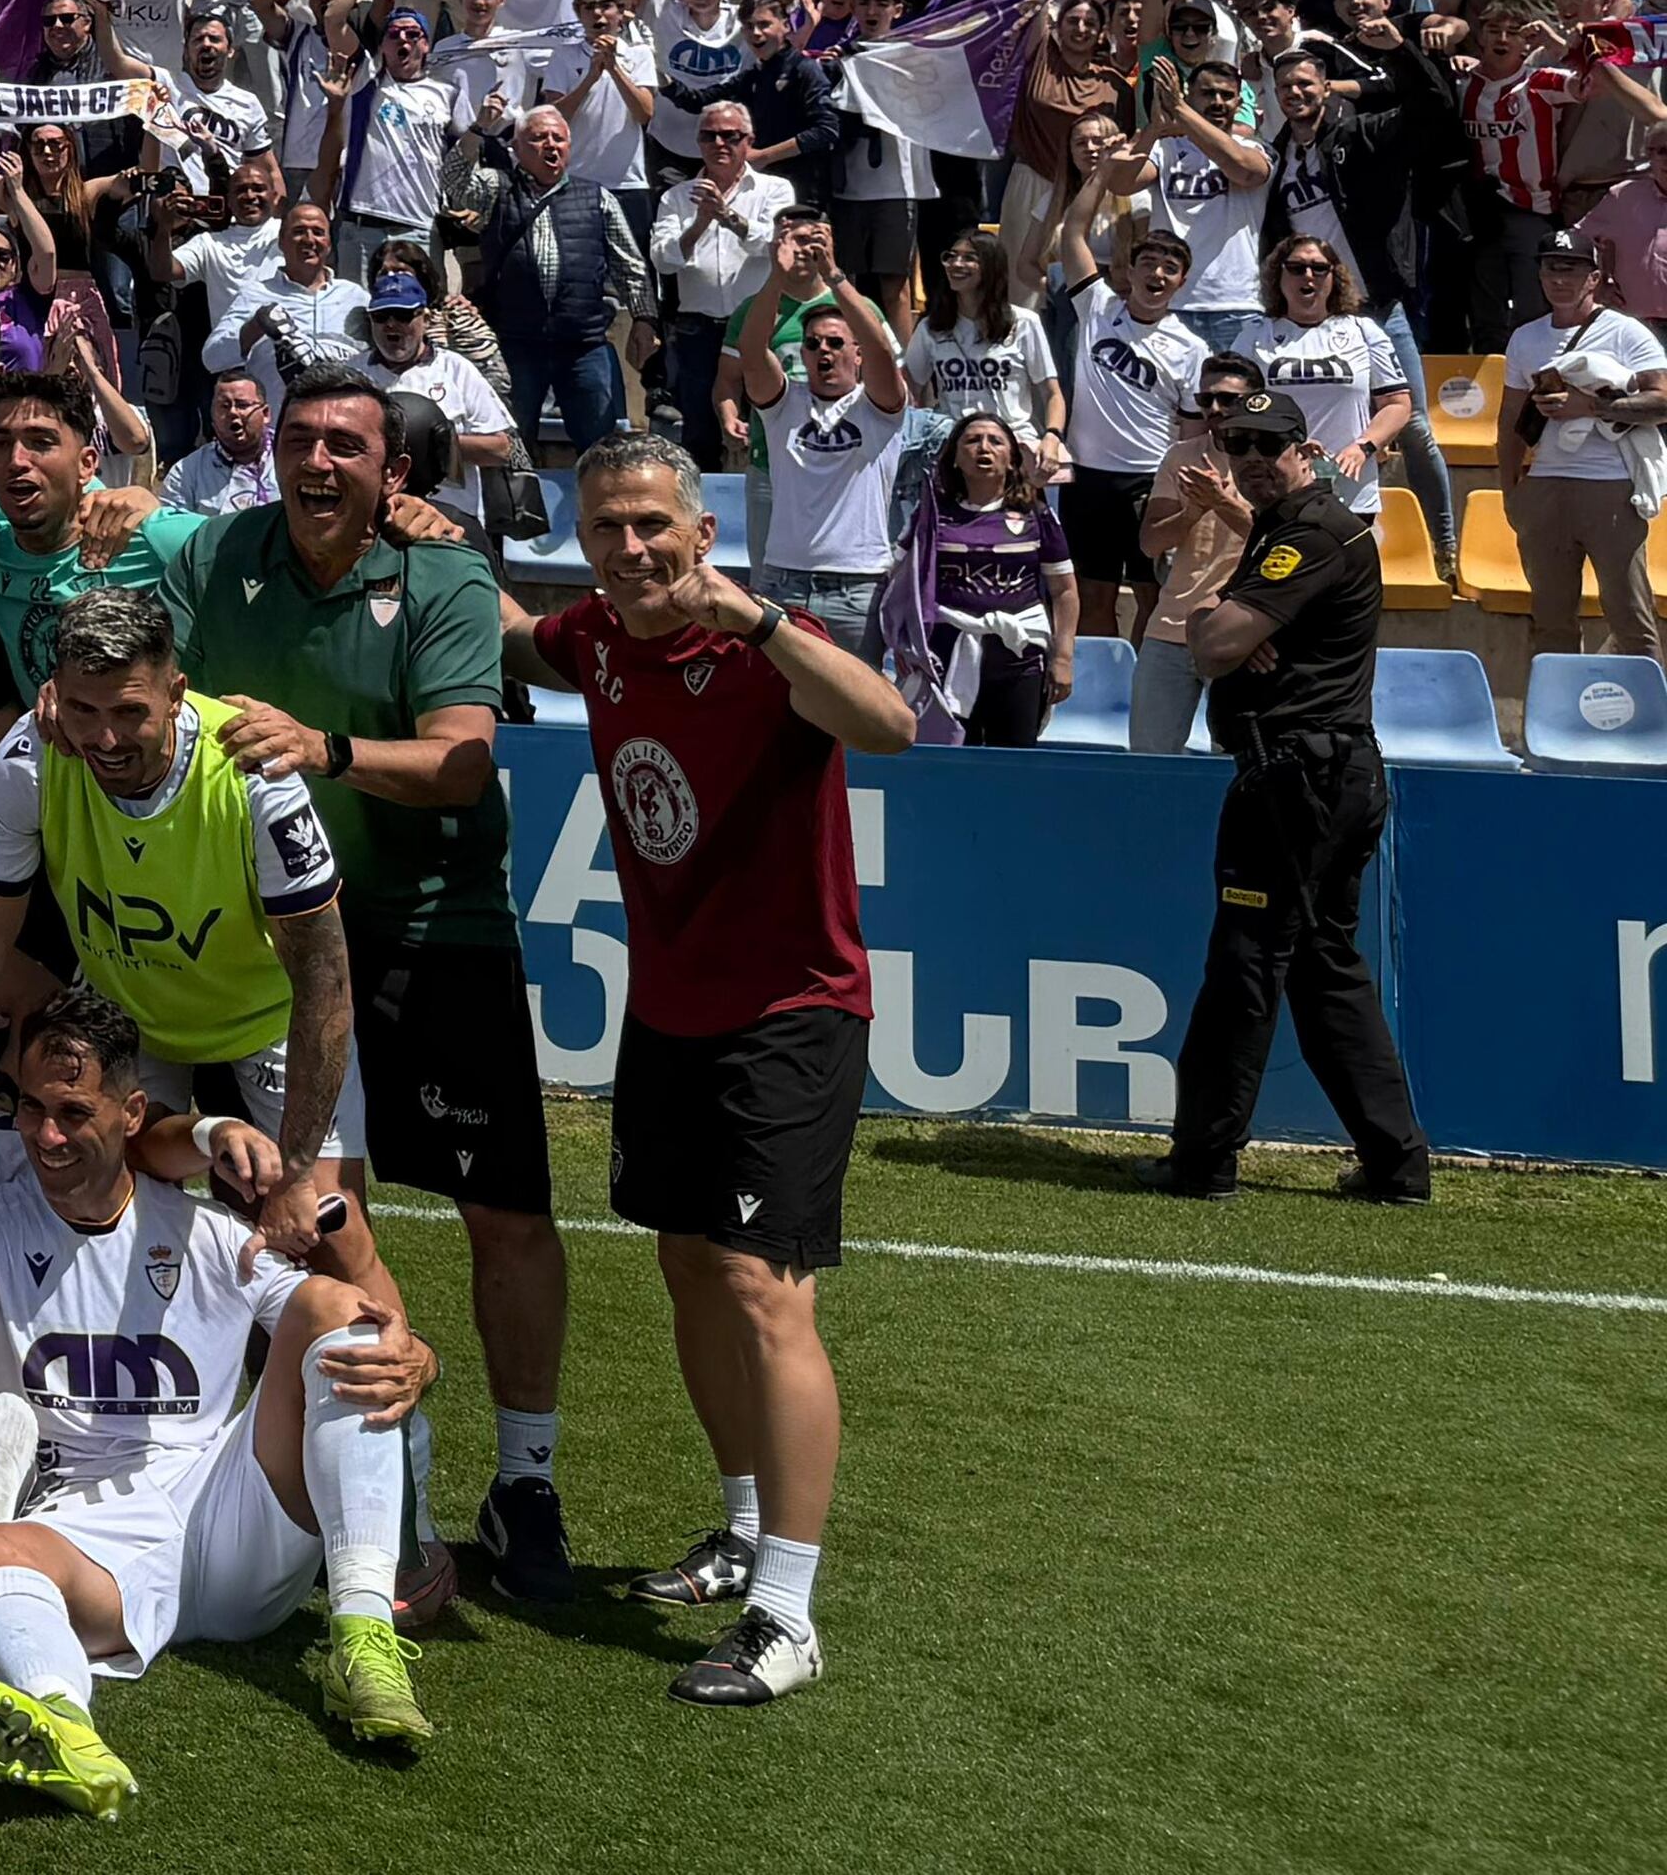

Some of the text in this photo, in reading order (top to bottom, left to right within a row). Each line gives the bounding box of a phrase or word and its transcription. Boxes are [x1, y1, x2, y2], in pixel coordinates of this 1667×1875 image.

[15, 84, 81, 118] JAÉN
[88, 84, 125, 114] CF
[28, 576, 52, 602] 22
